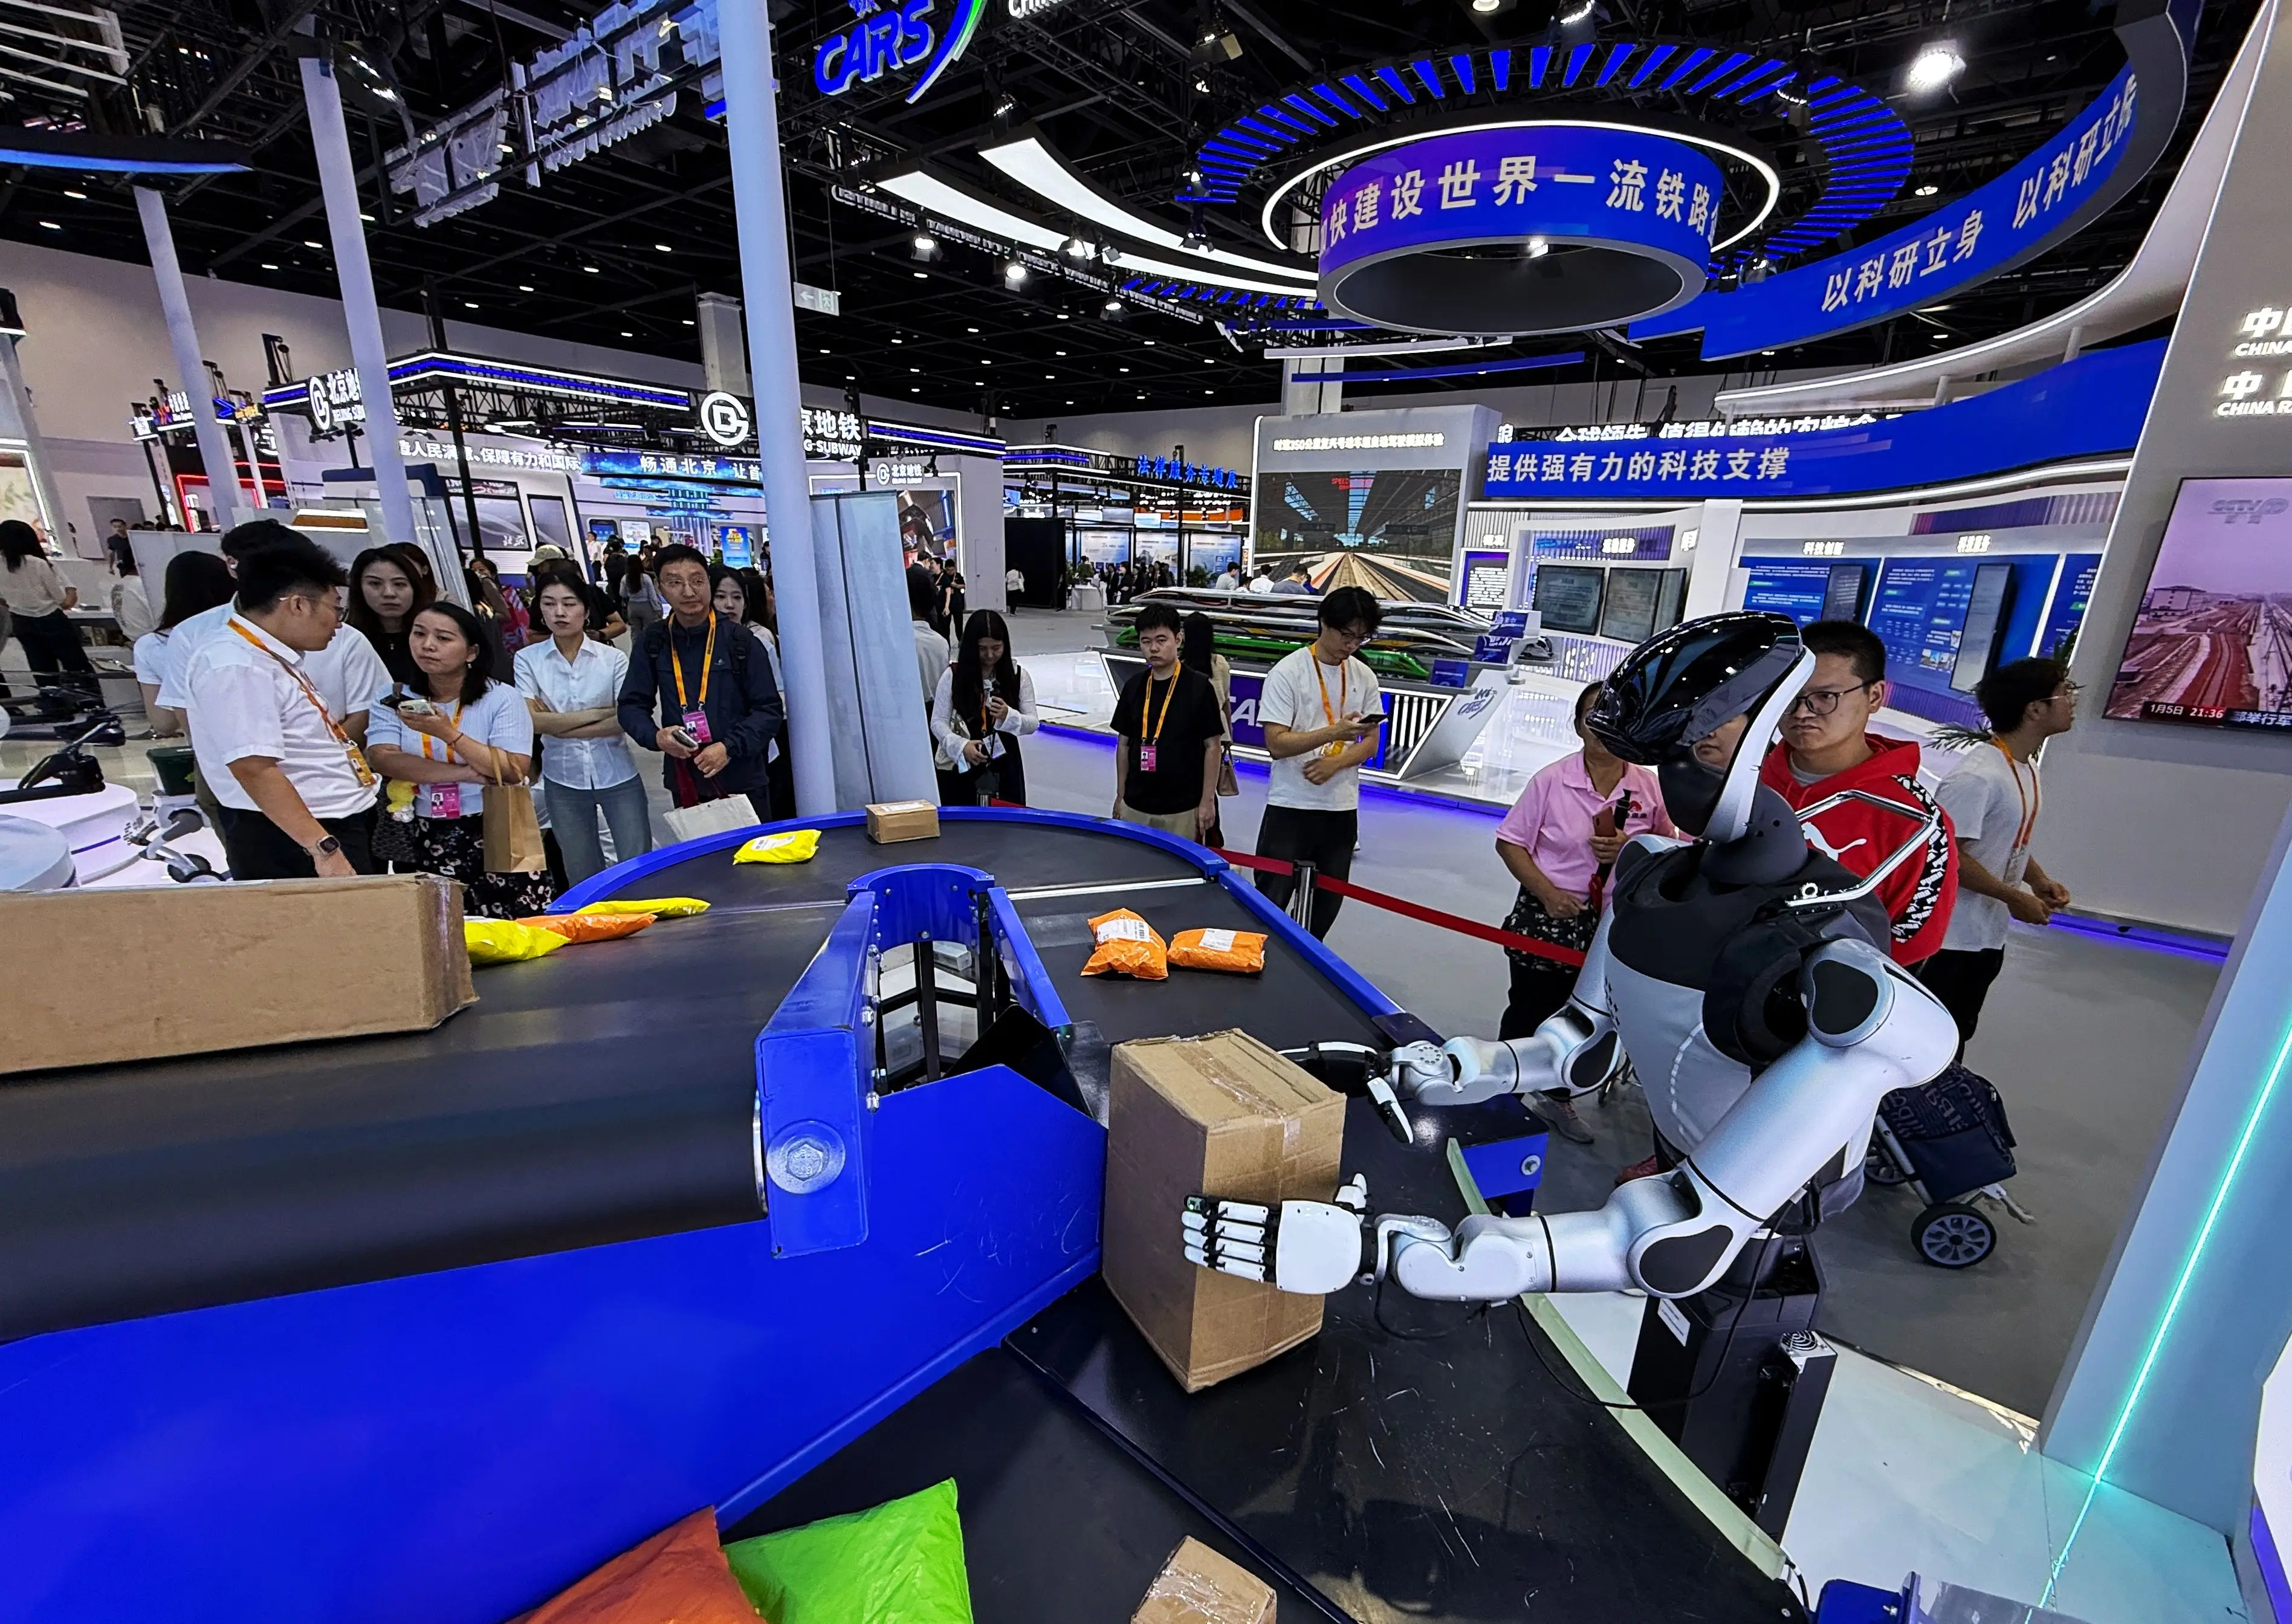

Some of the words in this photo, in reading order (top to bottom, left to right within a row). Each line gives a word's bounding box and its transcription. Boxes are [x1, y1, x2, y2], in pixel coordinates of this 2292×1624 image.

[814, 0, 936, 96] CARS
[1821, 209, 1983, 312] 以科研立身
[2241, 307, 2292, 338] 中
[2221, 370, 2292, 401] 中
[2216, 401, 2274, 416] CHINA
[816, 439, 863, 456] SUBWAY
[639, 455, 718, 476] 畅通北京
[1138, 454, 1238, 489] 法律服务专题展
[1487, 447, 1790, 482] 提供强有力的科技支撑
[2150, 704, 2184, 716] 1月5日
[2189, 707, 2225, 719] 21:36
